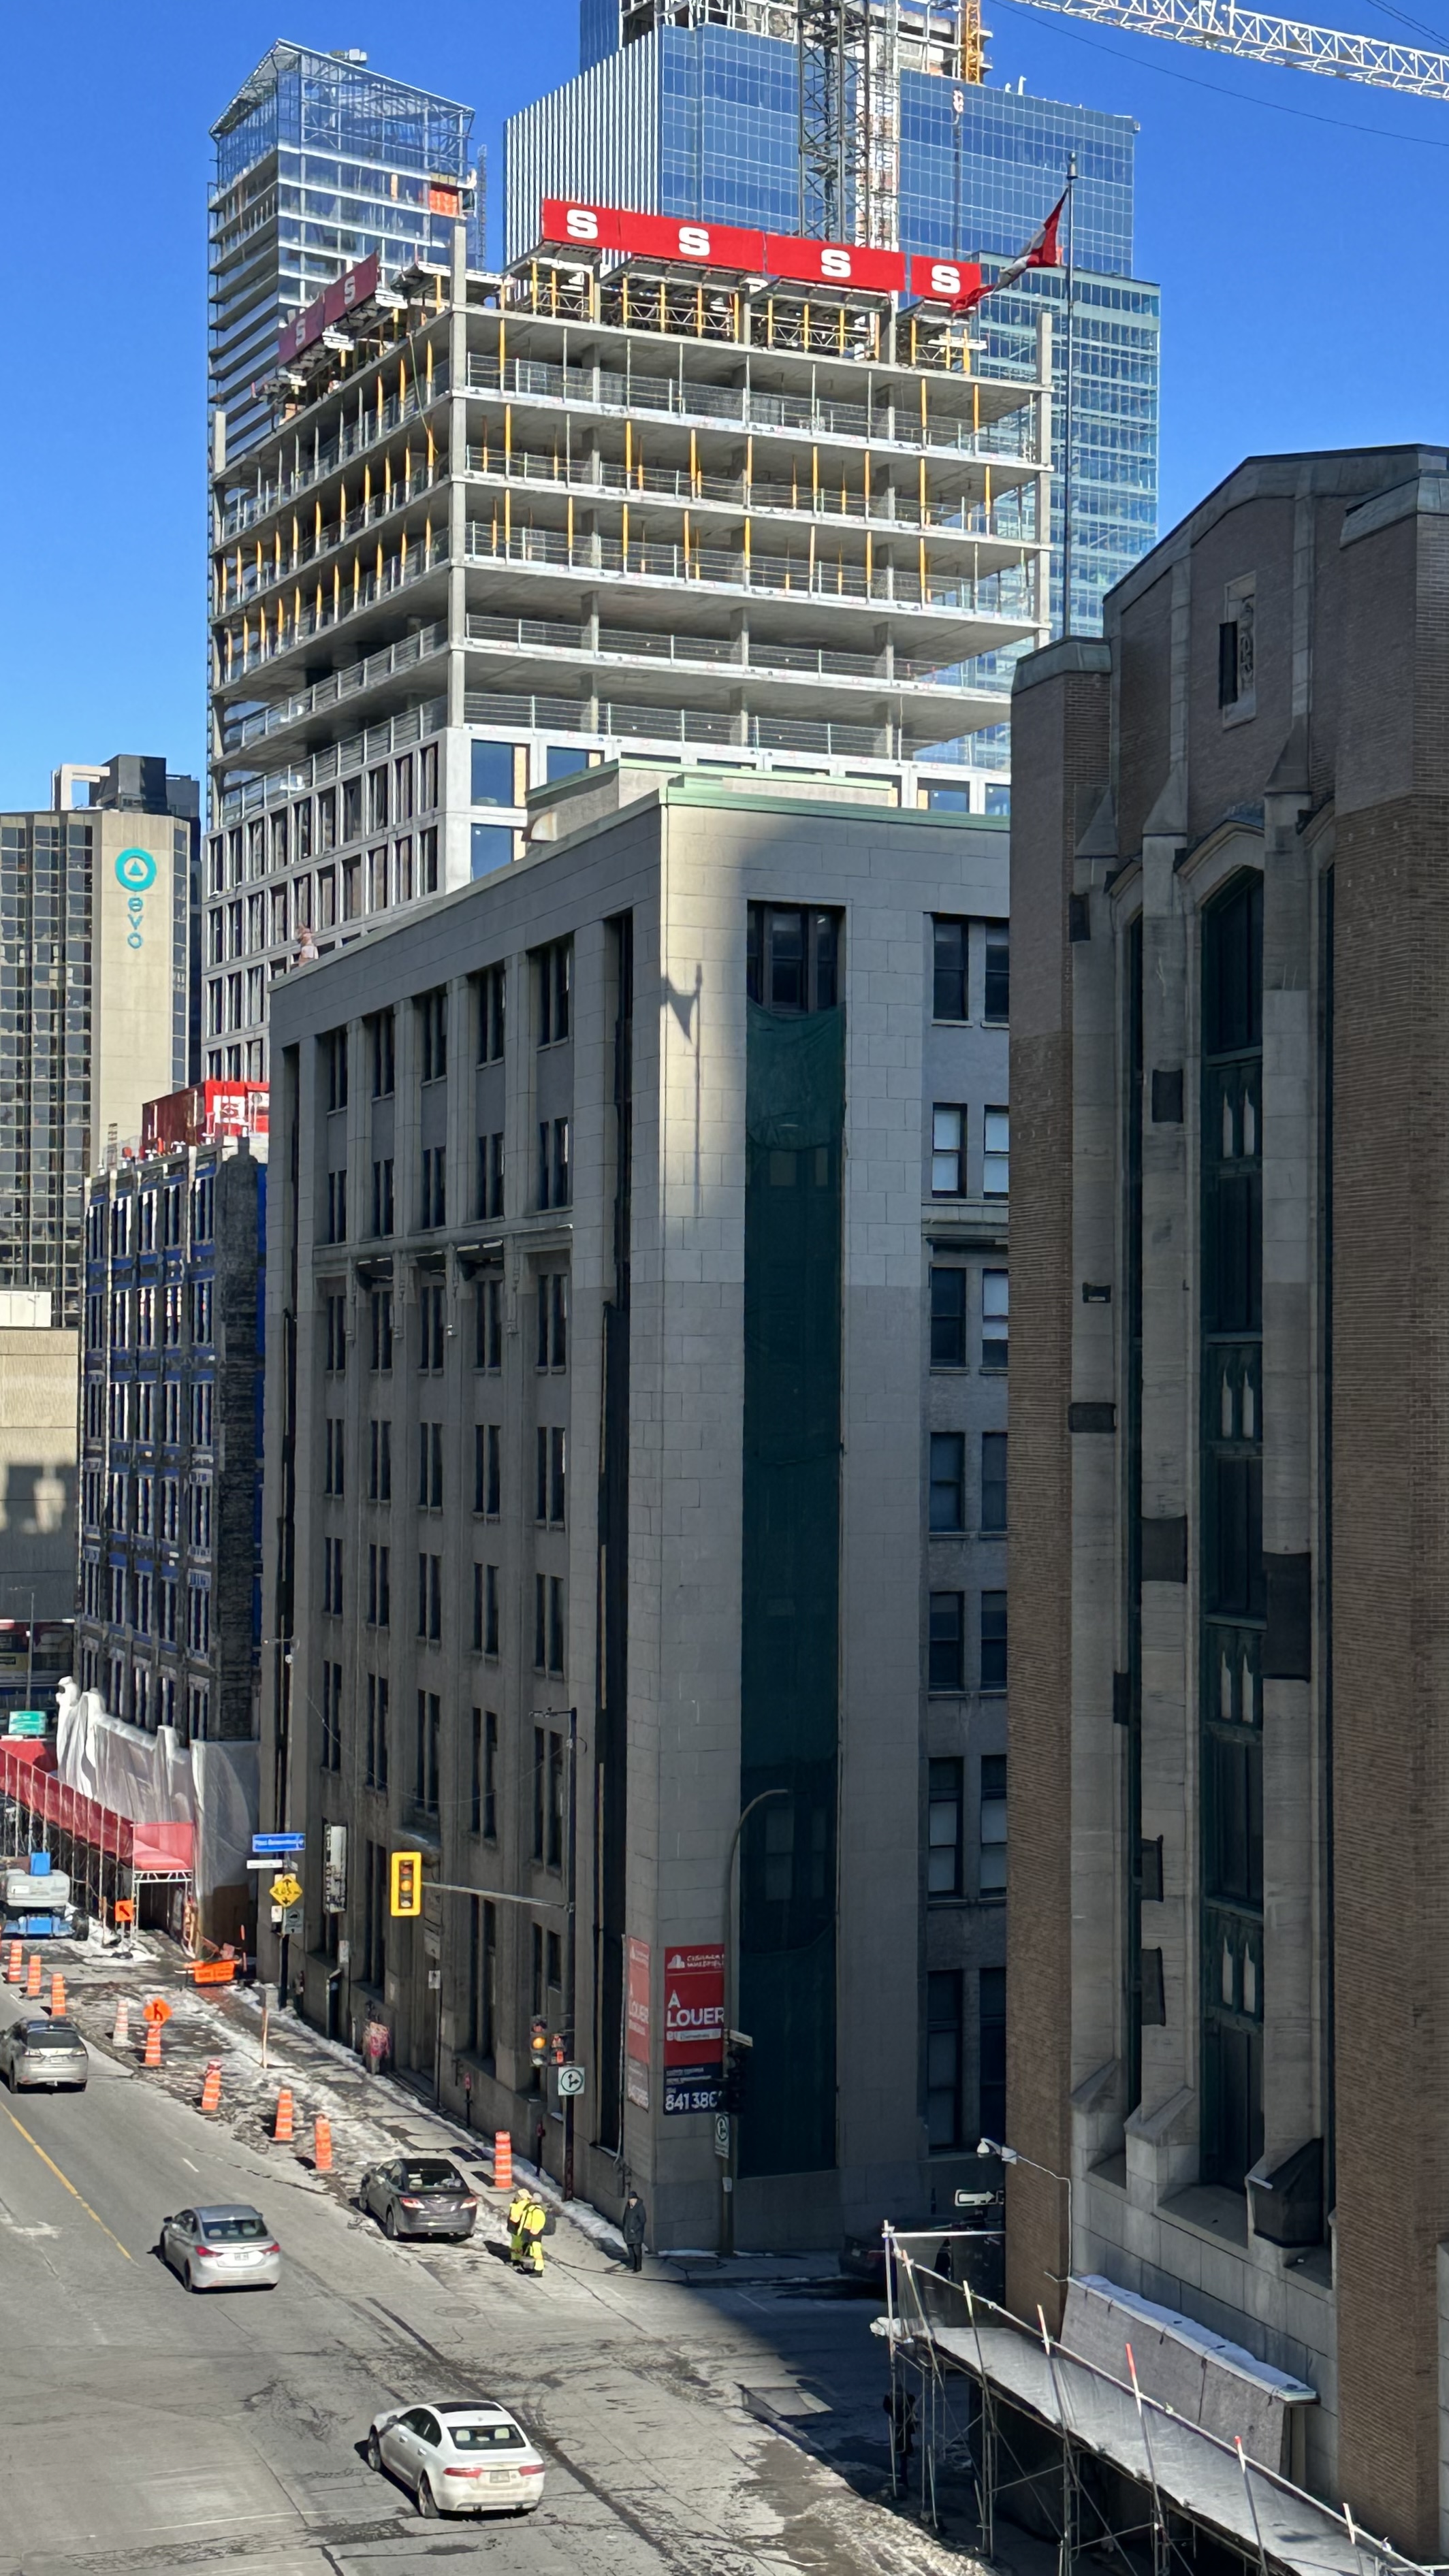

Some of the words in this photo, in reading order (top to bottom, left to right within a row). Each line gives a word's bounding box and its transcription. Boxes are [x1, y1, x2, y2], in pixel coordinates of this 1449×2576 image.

[567, 209, 599, 239] S
[678, 227, 710, 257] S
[821, 248, 851, 278] S
[344, 276, 355, 305] S
[931, 264, 961, 294] S
[296, 319, 306, 347] S
[667, 2007, 724, 2027] LOUER
